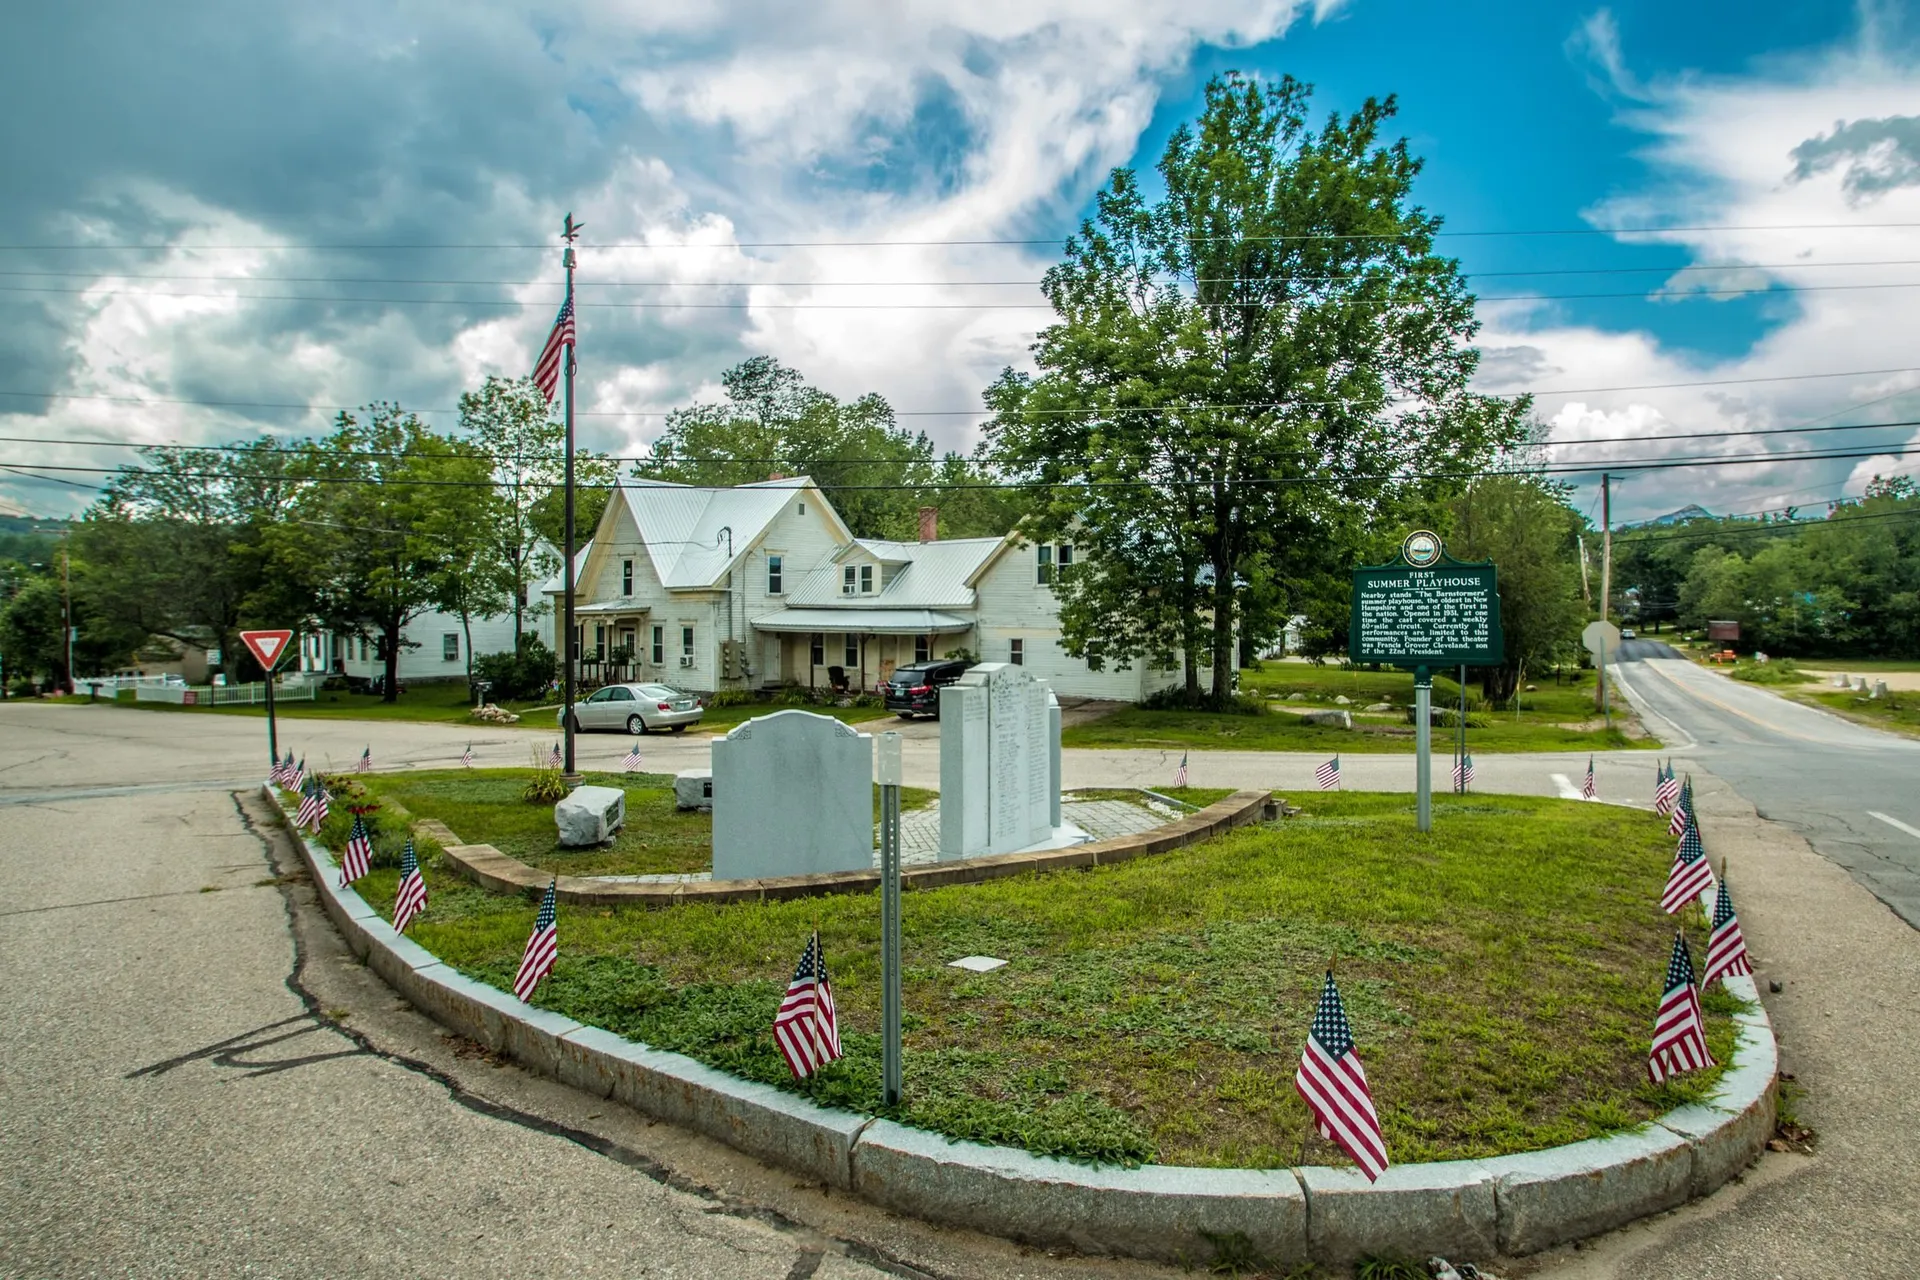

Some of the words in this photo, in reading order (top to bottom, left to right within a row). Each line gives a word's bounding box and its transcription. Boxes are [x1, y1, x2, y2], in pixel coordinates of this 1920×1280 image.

[1368, 580, 1410, 588] SUMMER
[1416, 578, 1480, 587] PLAYHOUSE
[1404, 610, 1430, 618] Opened
